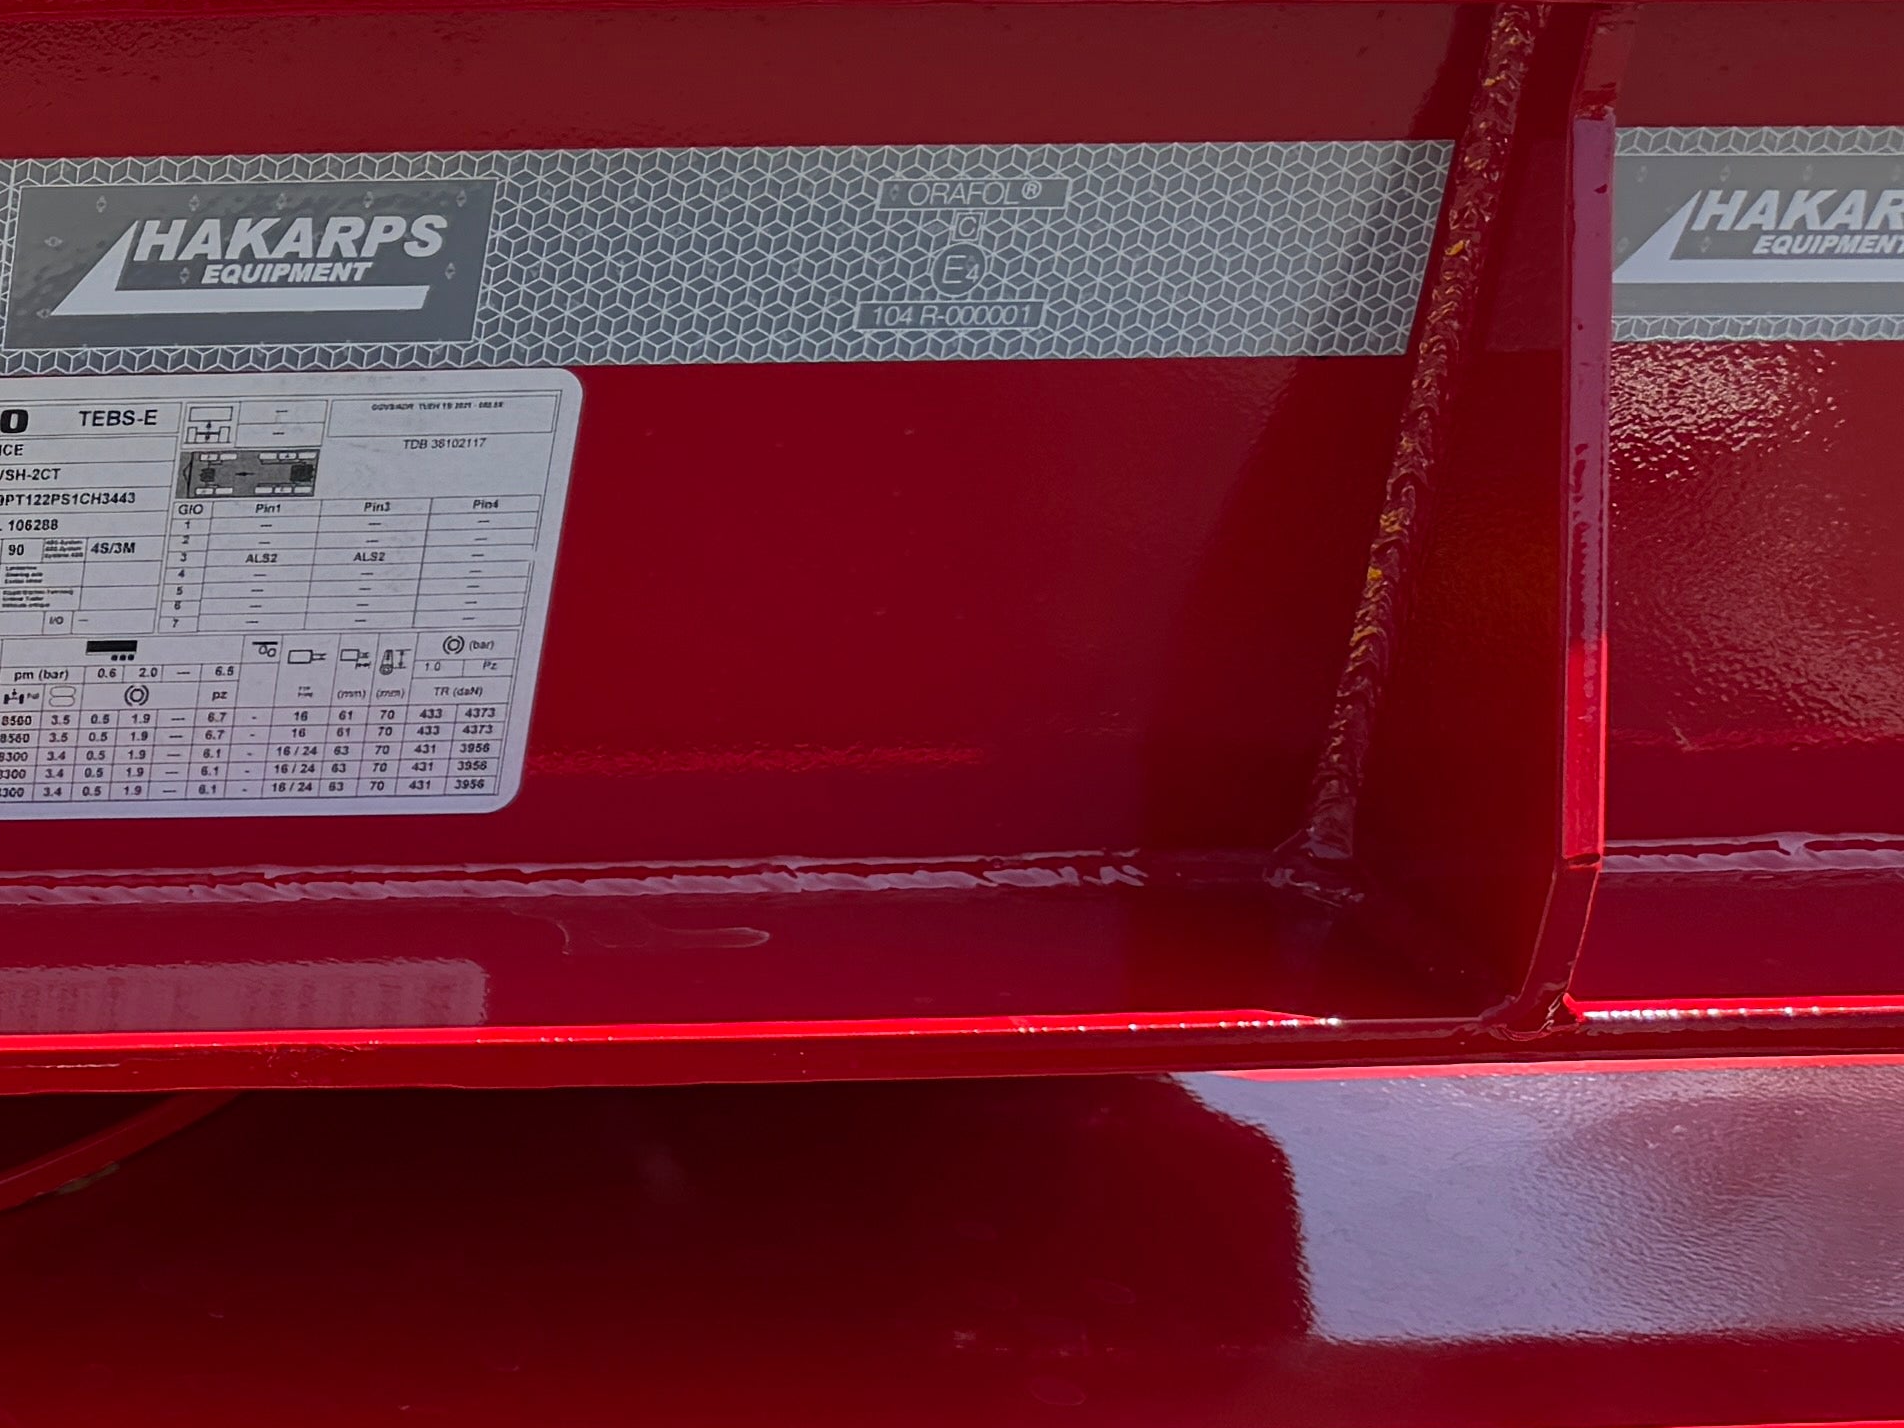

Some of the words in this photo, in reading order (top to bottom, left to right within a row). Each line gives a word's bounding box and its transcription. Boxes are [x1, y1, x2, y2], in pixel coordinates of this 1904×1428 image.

[958, 216, 977, 237] C
[132, 214, 447, 262] HAKARPS
[201, 262, 372, 285] EQUIPMENT
[873, 306, 913, 326] 104
[920, 305, 1031, 326] R-000001
[79, 410, 159, 427] TEBS-E
[8, 544, 25, 556] 90
